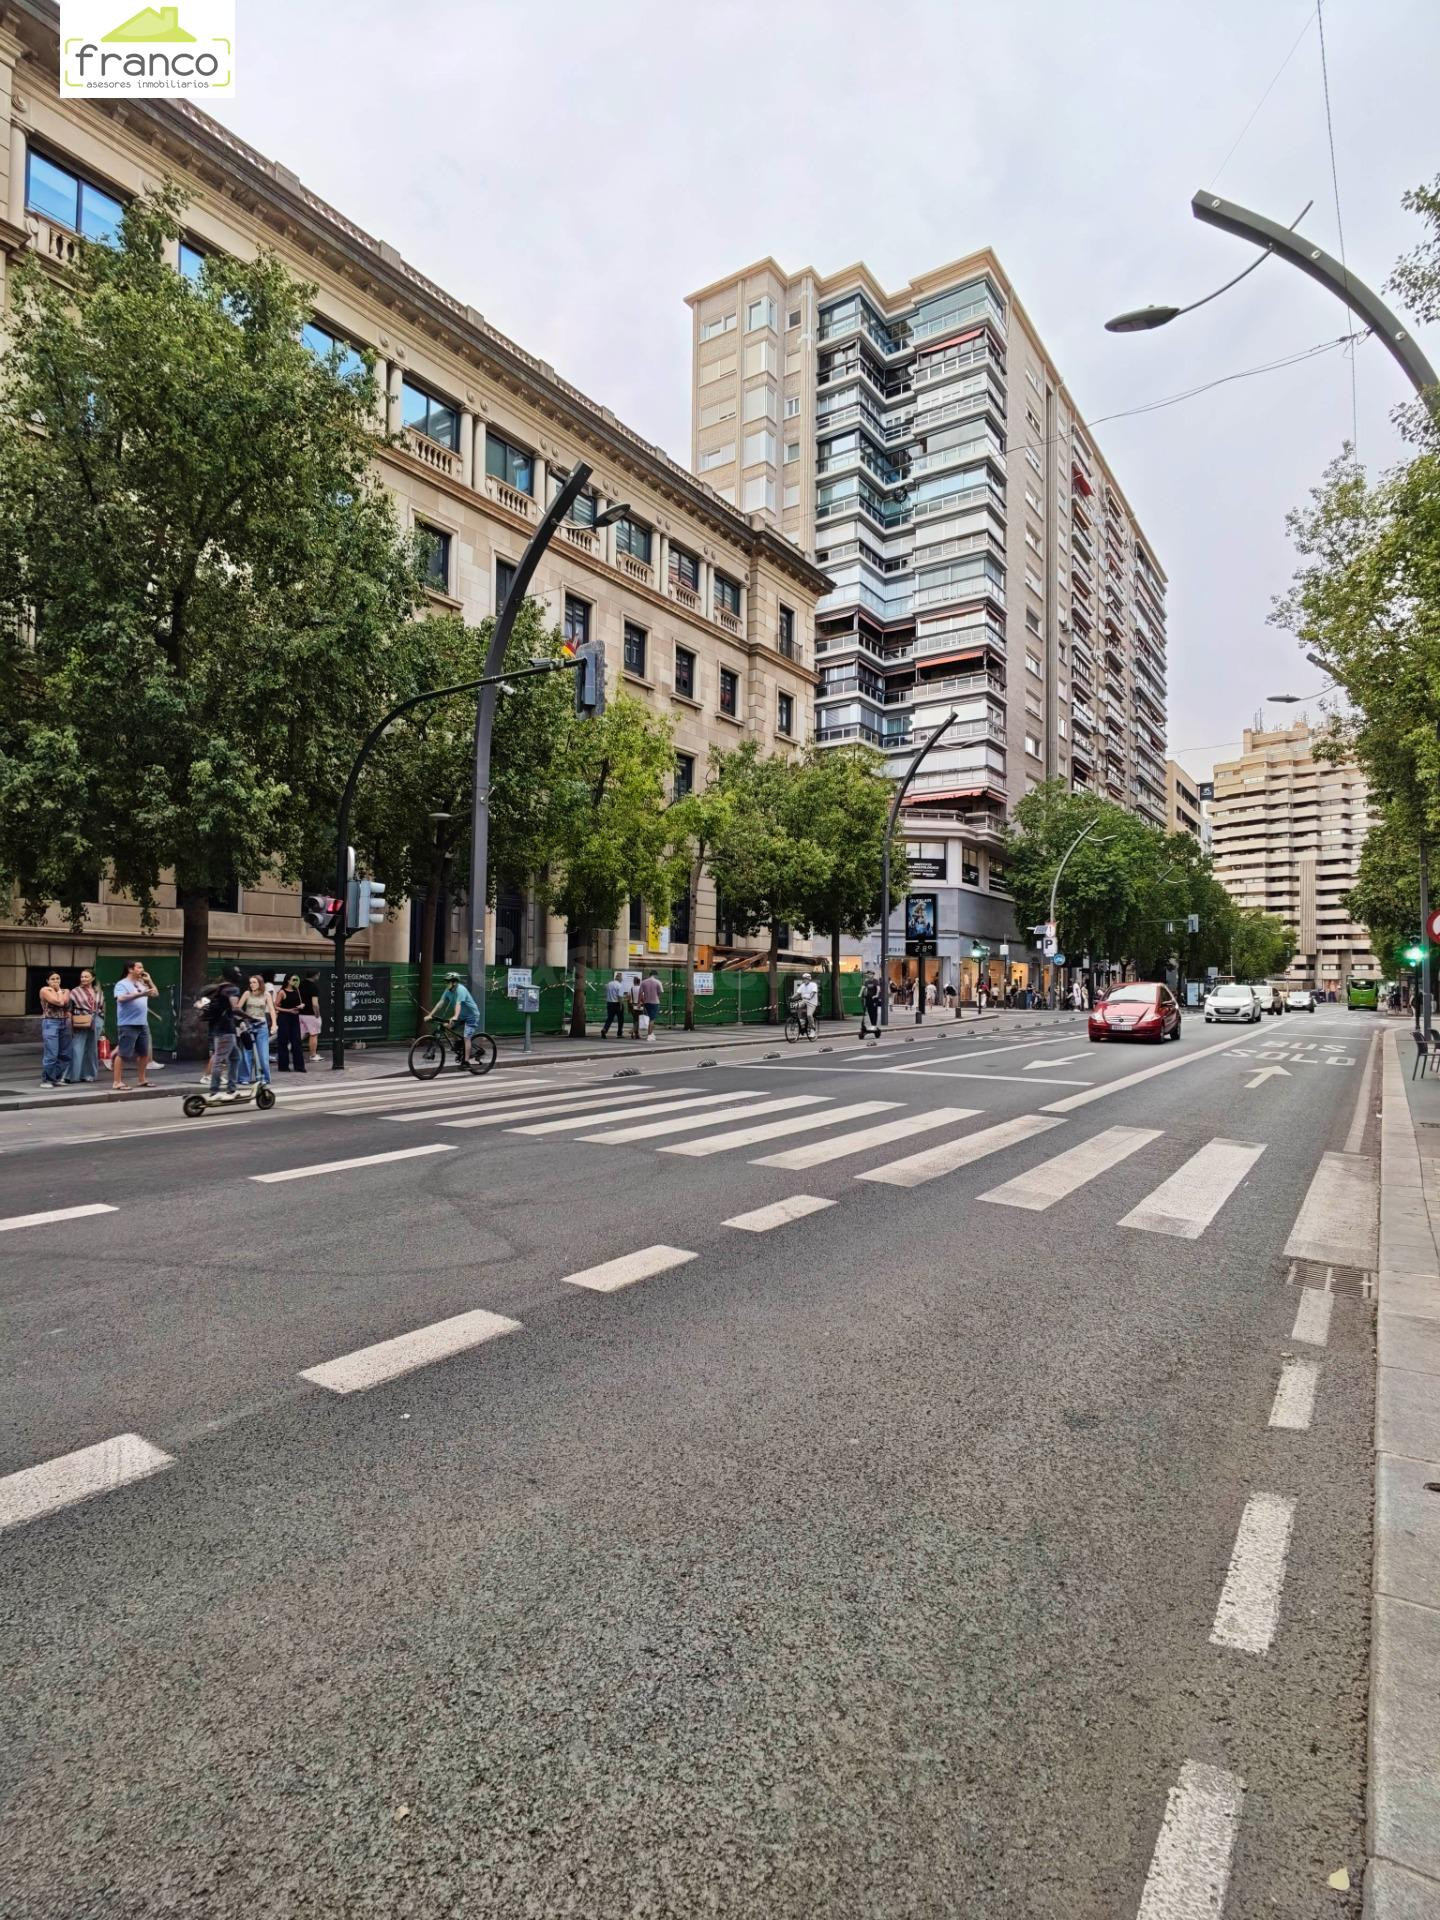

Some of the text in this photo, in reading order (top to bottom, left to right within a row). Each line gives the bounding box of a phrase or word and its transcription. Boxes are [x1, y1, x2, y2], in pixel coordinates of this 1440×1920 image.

[1045, 939, 1053, 949] P
[367, 1014, 382, 1022] 309
[1260, 1040, 1348, 1053] BUS
[1220, 1048, 1357, 1067] SOLO
